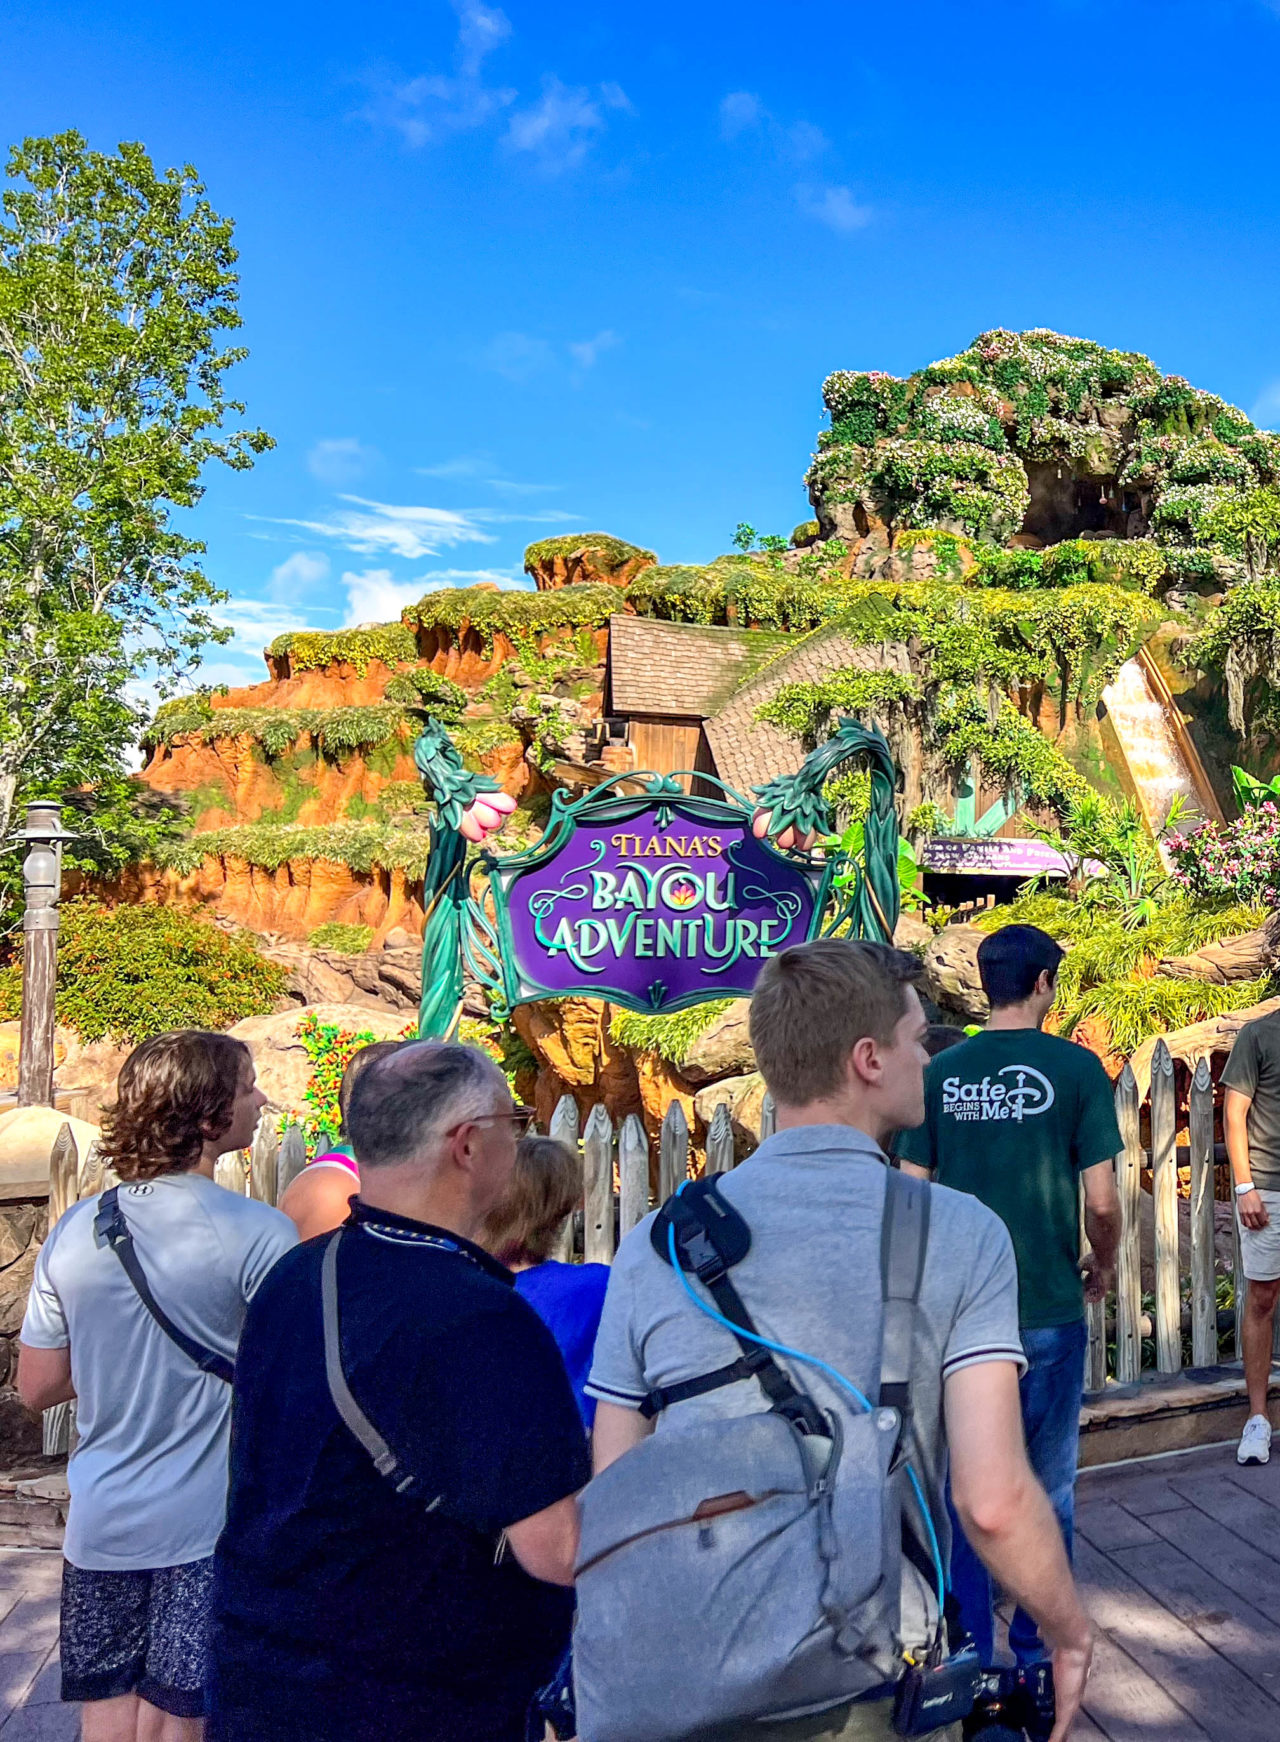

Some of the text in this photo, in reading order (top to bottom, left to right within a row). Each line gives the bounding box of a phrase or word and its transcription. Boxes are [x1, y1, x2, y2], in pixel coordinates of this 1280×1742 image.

[611, 833, 722, 858] TIANA'S
[591, 862, 738, 911] BAYOU
[547, 911, 781, 973] ADVENTURE
[942, 1076, 1006, 1103] Safe
[943, 1102, 980, 1113] BEGINS
[954, 1101, 1009, 1121] WITH Me
